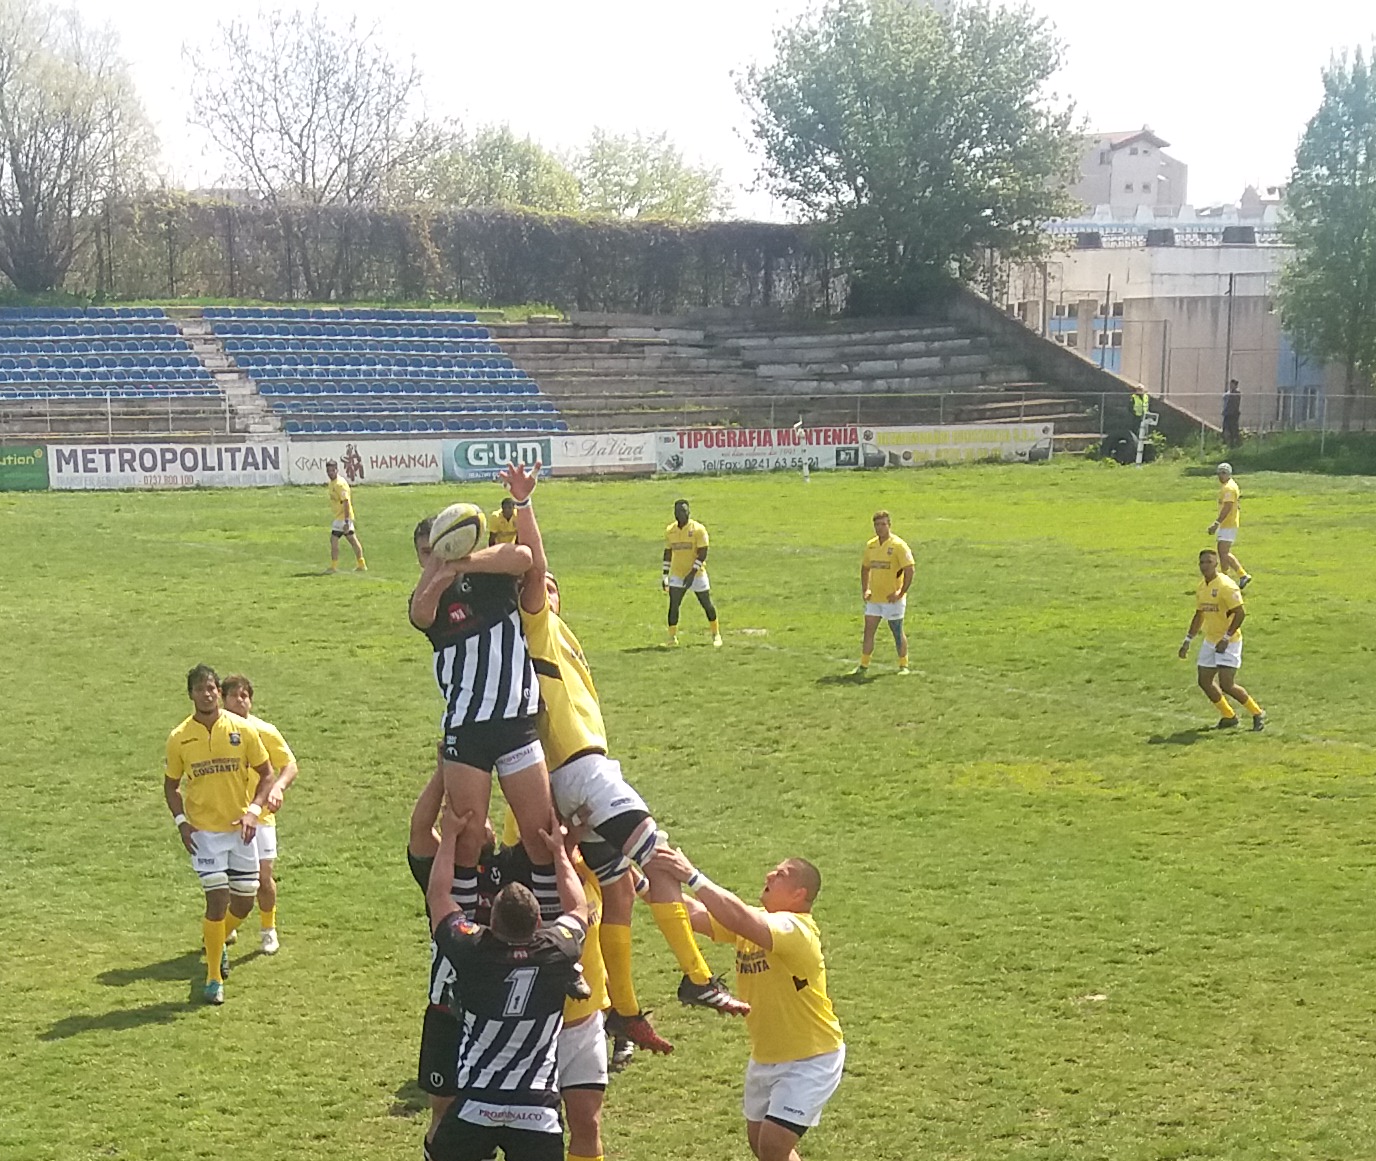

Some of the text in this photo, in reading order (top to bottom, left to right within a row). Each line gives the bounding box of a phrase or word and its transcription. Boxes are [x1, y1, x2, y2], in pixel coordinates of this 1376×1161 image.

[676, 429, 773, 449] TIPOGRAFIA
[776, 427, 859, 446] MUNTENIA
[56, 446, 280, 474] METROPOLITAN
[295, 454, 438, 471] CRAM HAMANGIA
[744, 458, 770, 469] 0241
[774, 457, 787, 468] 63
[143, 475, 162, 485] 0737
[180, 475, 194, 485] 100
[503, 967, 540, 1017] 1
